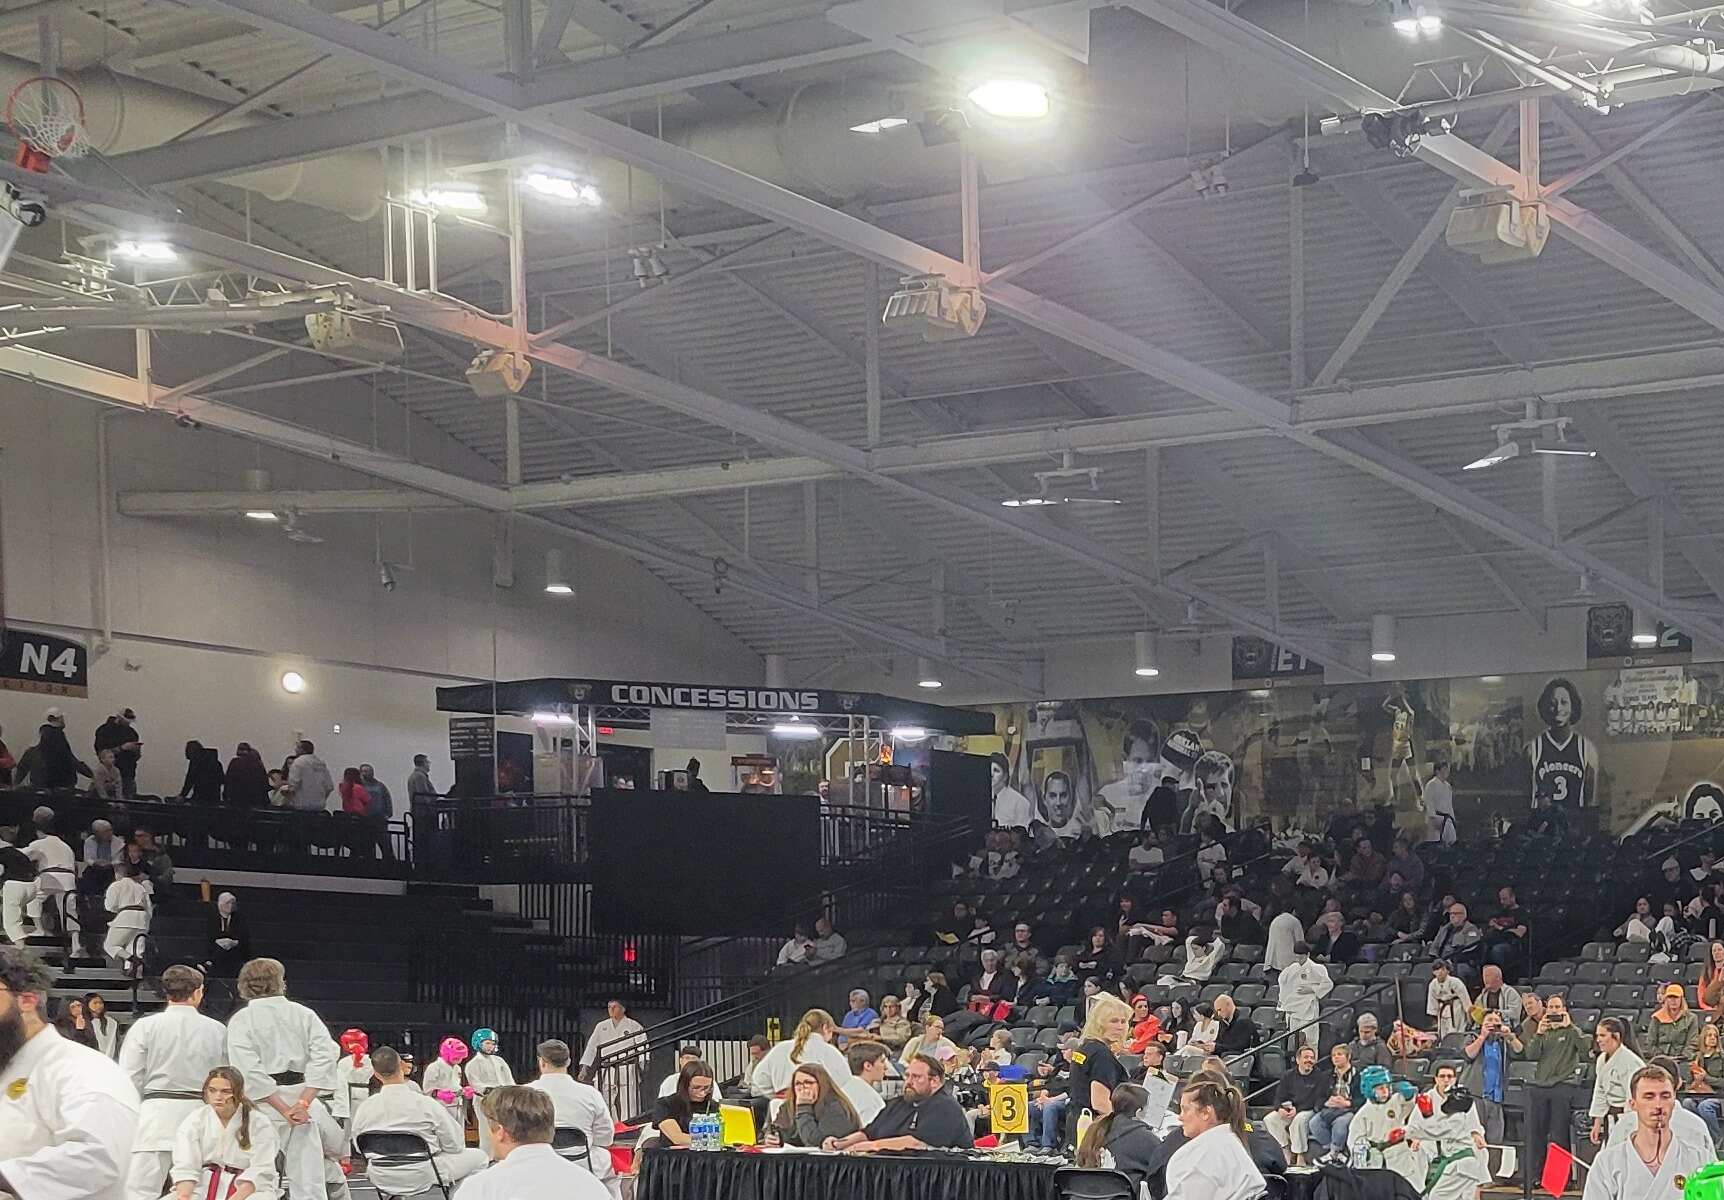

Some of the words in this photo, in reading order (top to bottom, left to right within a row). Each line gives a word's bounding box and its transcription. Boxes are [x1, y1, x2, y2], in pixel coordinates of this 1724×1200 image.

[19, 642, 78, 679] N4
[611, 684, 820, 710] CONCESSIONS
[1538, 761, 1583, 781] pioneers
[1552, 775, 1568, 801] 3
[1001, 1096, 1017, 1122] 3
